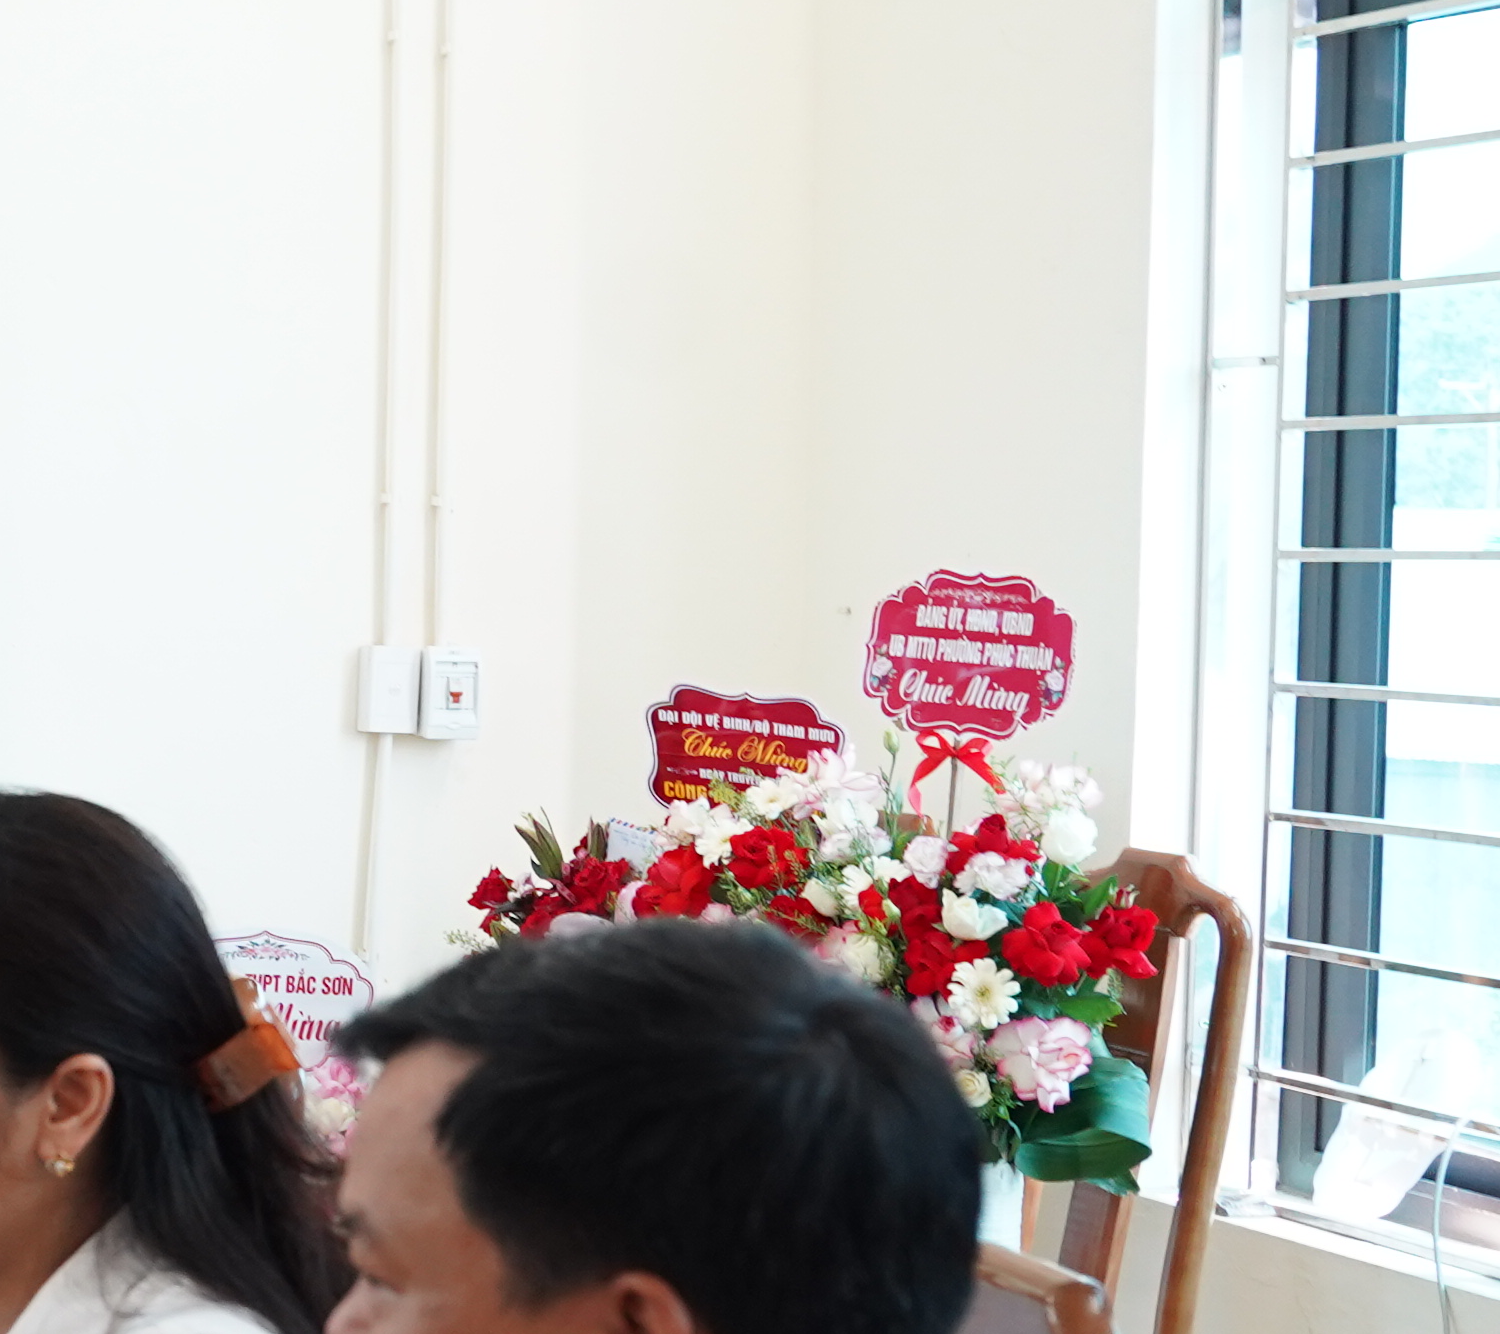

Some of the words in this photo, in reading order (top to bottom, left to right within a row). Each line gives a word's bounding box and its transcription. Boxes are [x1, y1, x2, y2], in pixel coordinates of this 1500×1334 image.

[982, 638, 1016, 667] PHÚC
[1015, 642, 1054, 675] THUẬN
[899, 668, 954, 704] Chúc
[955, 674, 1030, 720] Mừng
[705, 713, 721, 731] VỆ
[773, 722, 806, 740] THAM
[681, 728, 733, 760] Chúc
[737, 736, 808, 774] Mừng
[285, 967, 317, 995] BẮC
[321, 975, 353, 996] SƠN
